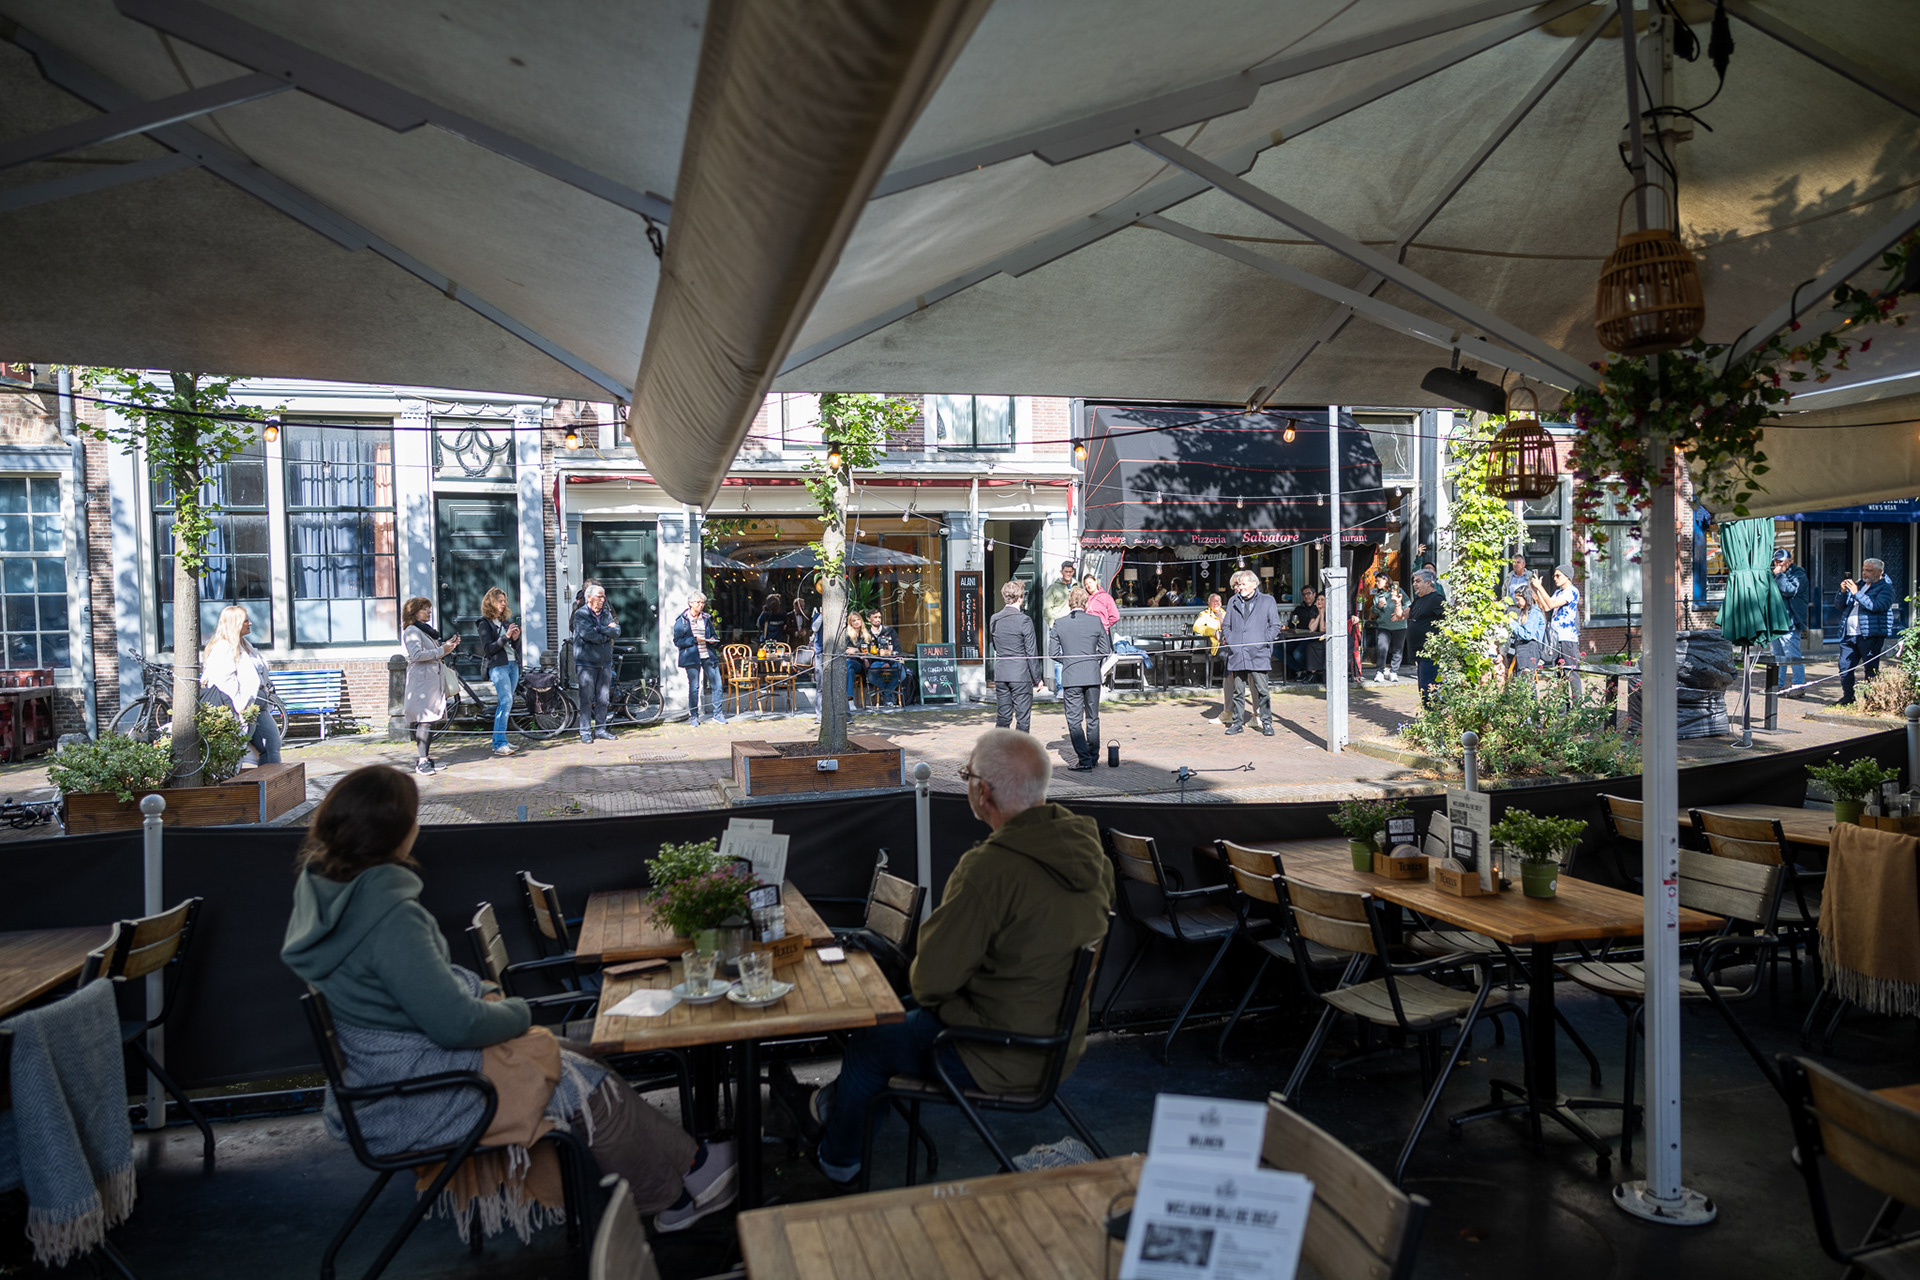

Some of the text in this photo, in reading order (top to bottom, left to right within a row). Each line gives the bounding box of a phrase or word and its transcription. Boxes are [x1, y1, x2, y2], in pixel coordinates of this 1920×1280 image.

[1191, 531, 1368, 544] Pizzeria Salvatore Reaurant
